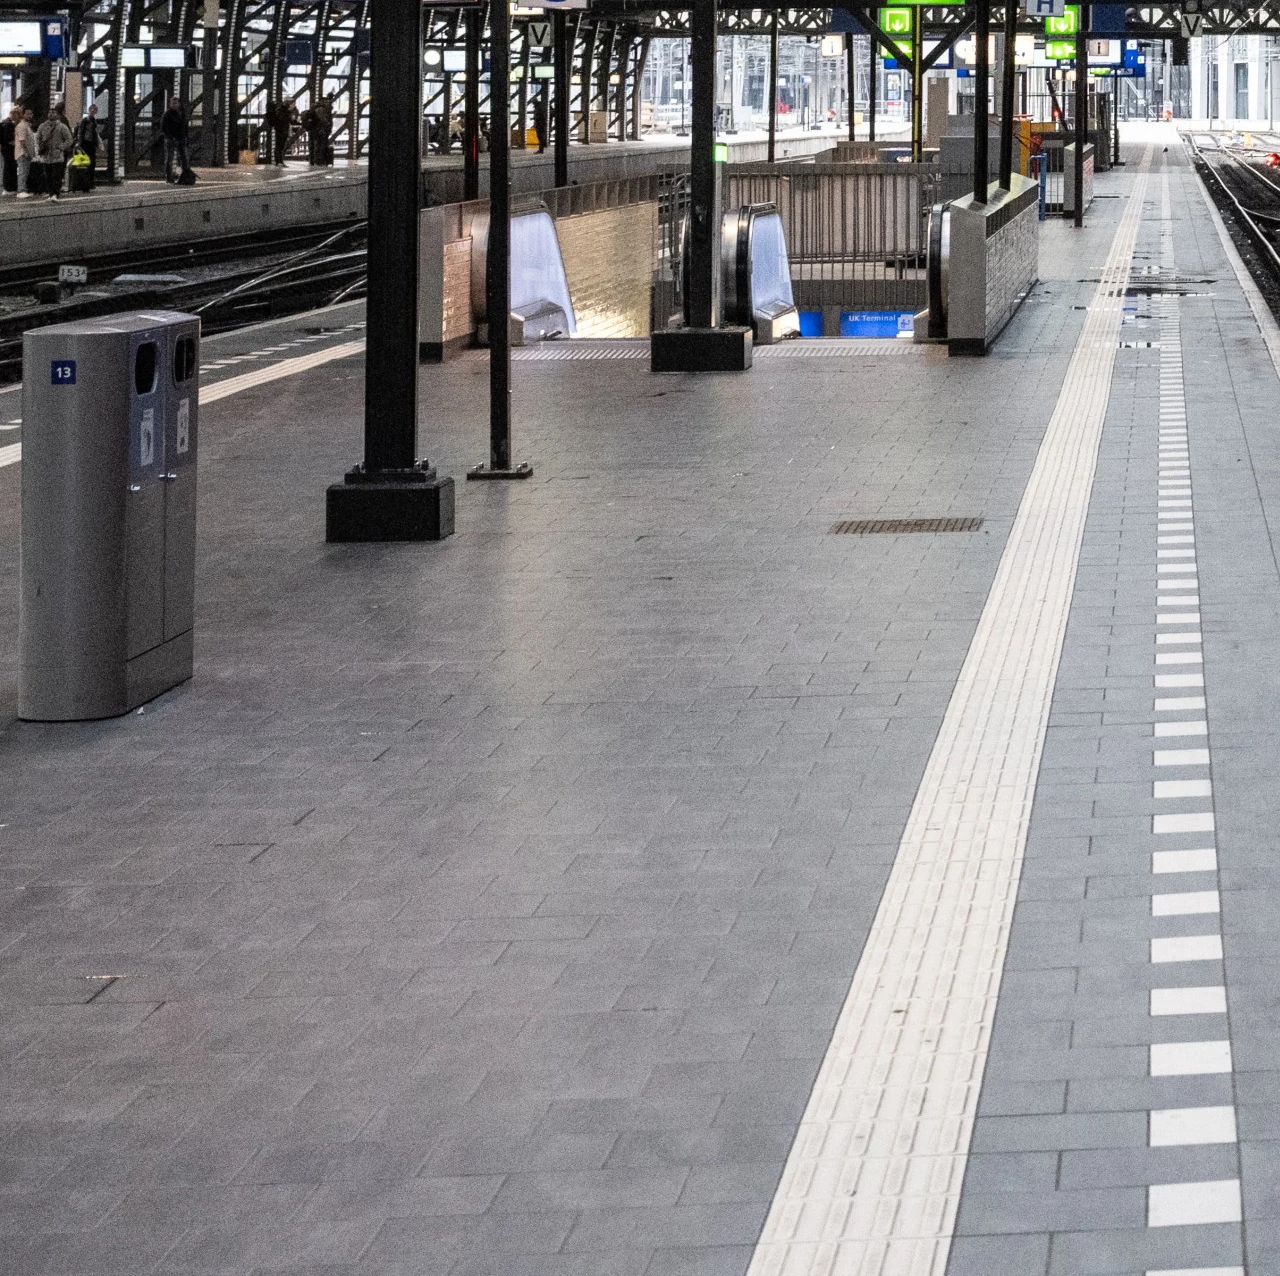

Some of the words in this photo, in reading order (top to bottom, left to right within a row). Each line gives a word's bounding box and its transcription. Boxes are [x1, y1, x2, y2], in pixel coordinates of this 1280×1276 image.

[531, 24, 548, 45] V
[1183, 16, 1200, 35] V
[56, 366, 71, 379] 13
